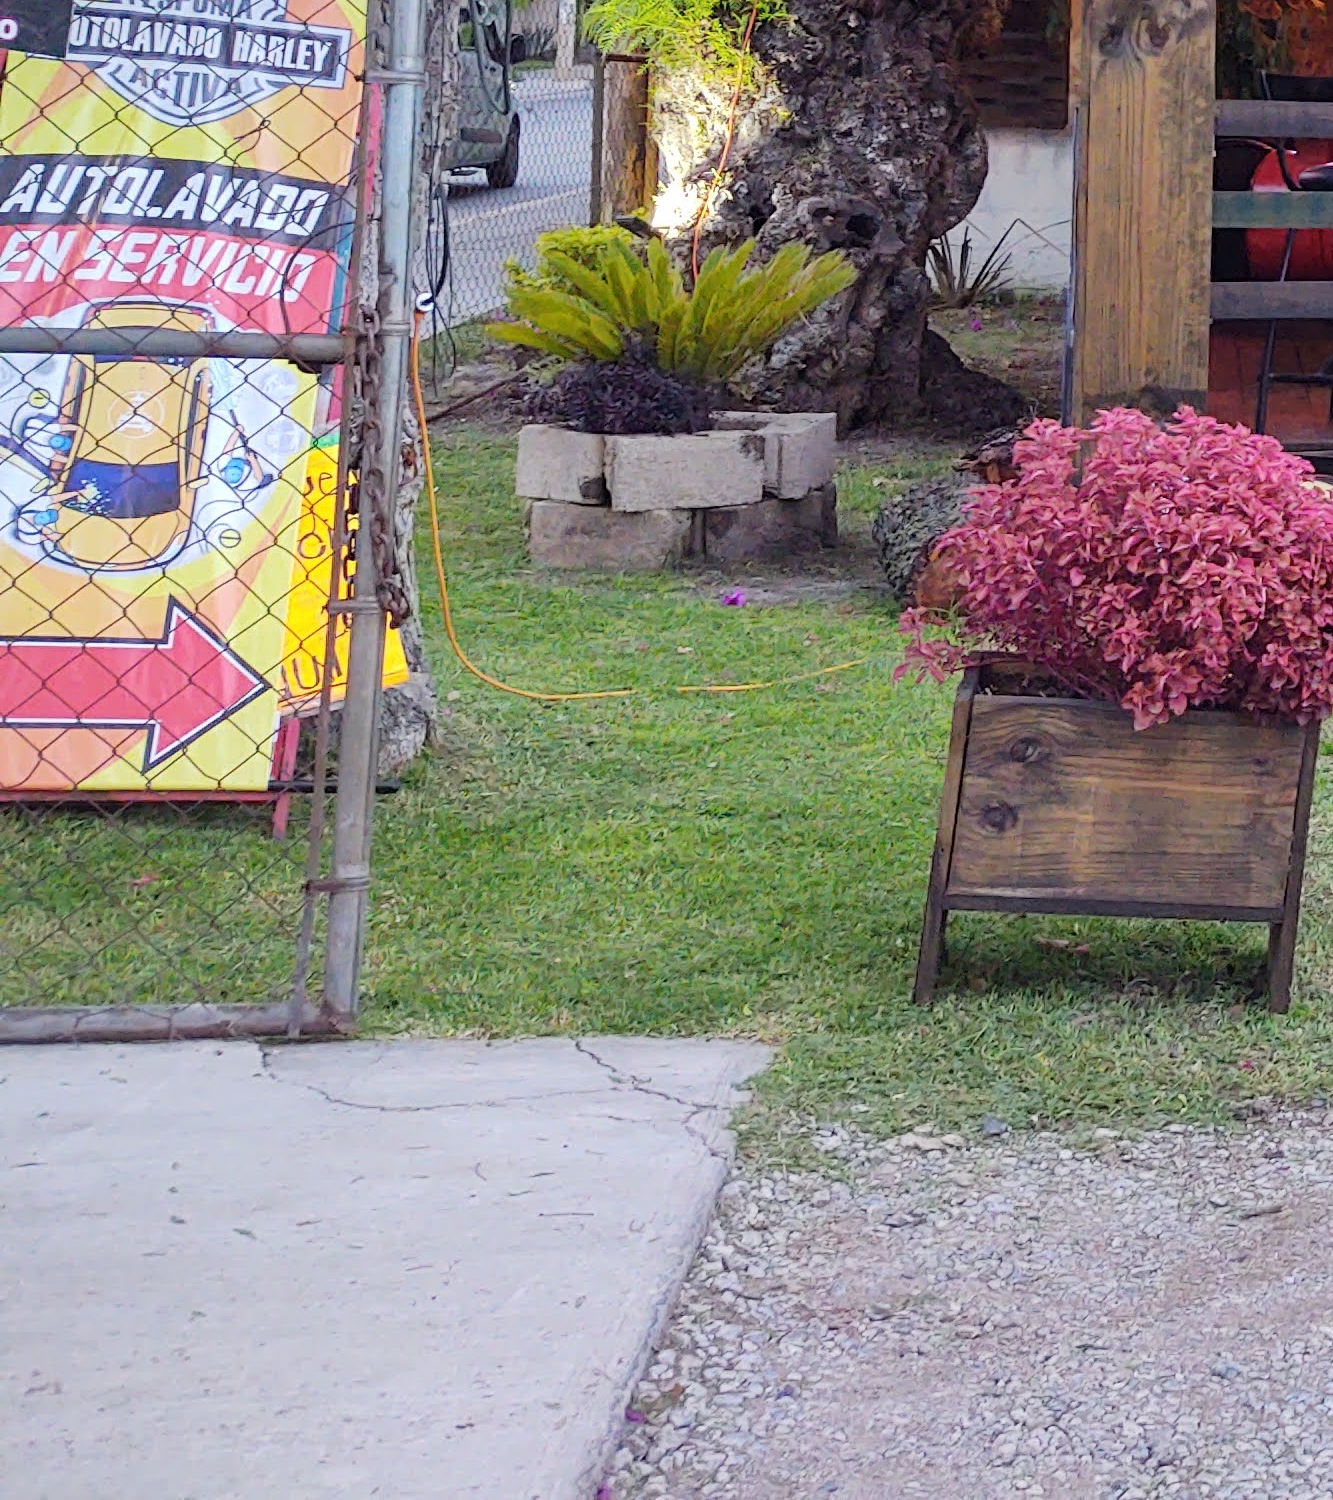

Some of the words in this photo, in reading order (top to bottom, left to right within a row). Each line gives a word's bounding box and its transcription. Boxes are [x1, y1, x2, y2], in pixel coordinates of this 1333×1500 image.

[70, 14, 223, 59] UTOLAVADO
[232, 29, 333, 72] HARLEY
[131, 66, 243, 107] ACTIVA
[0, 163, 329, 237] AUTOLAVADO
[0, 230, 78, 283] EN
[73, 229, 316, 303] SERVICIO
